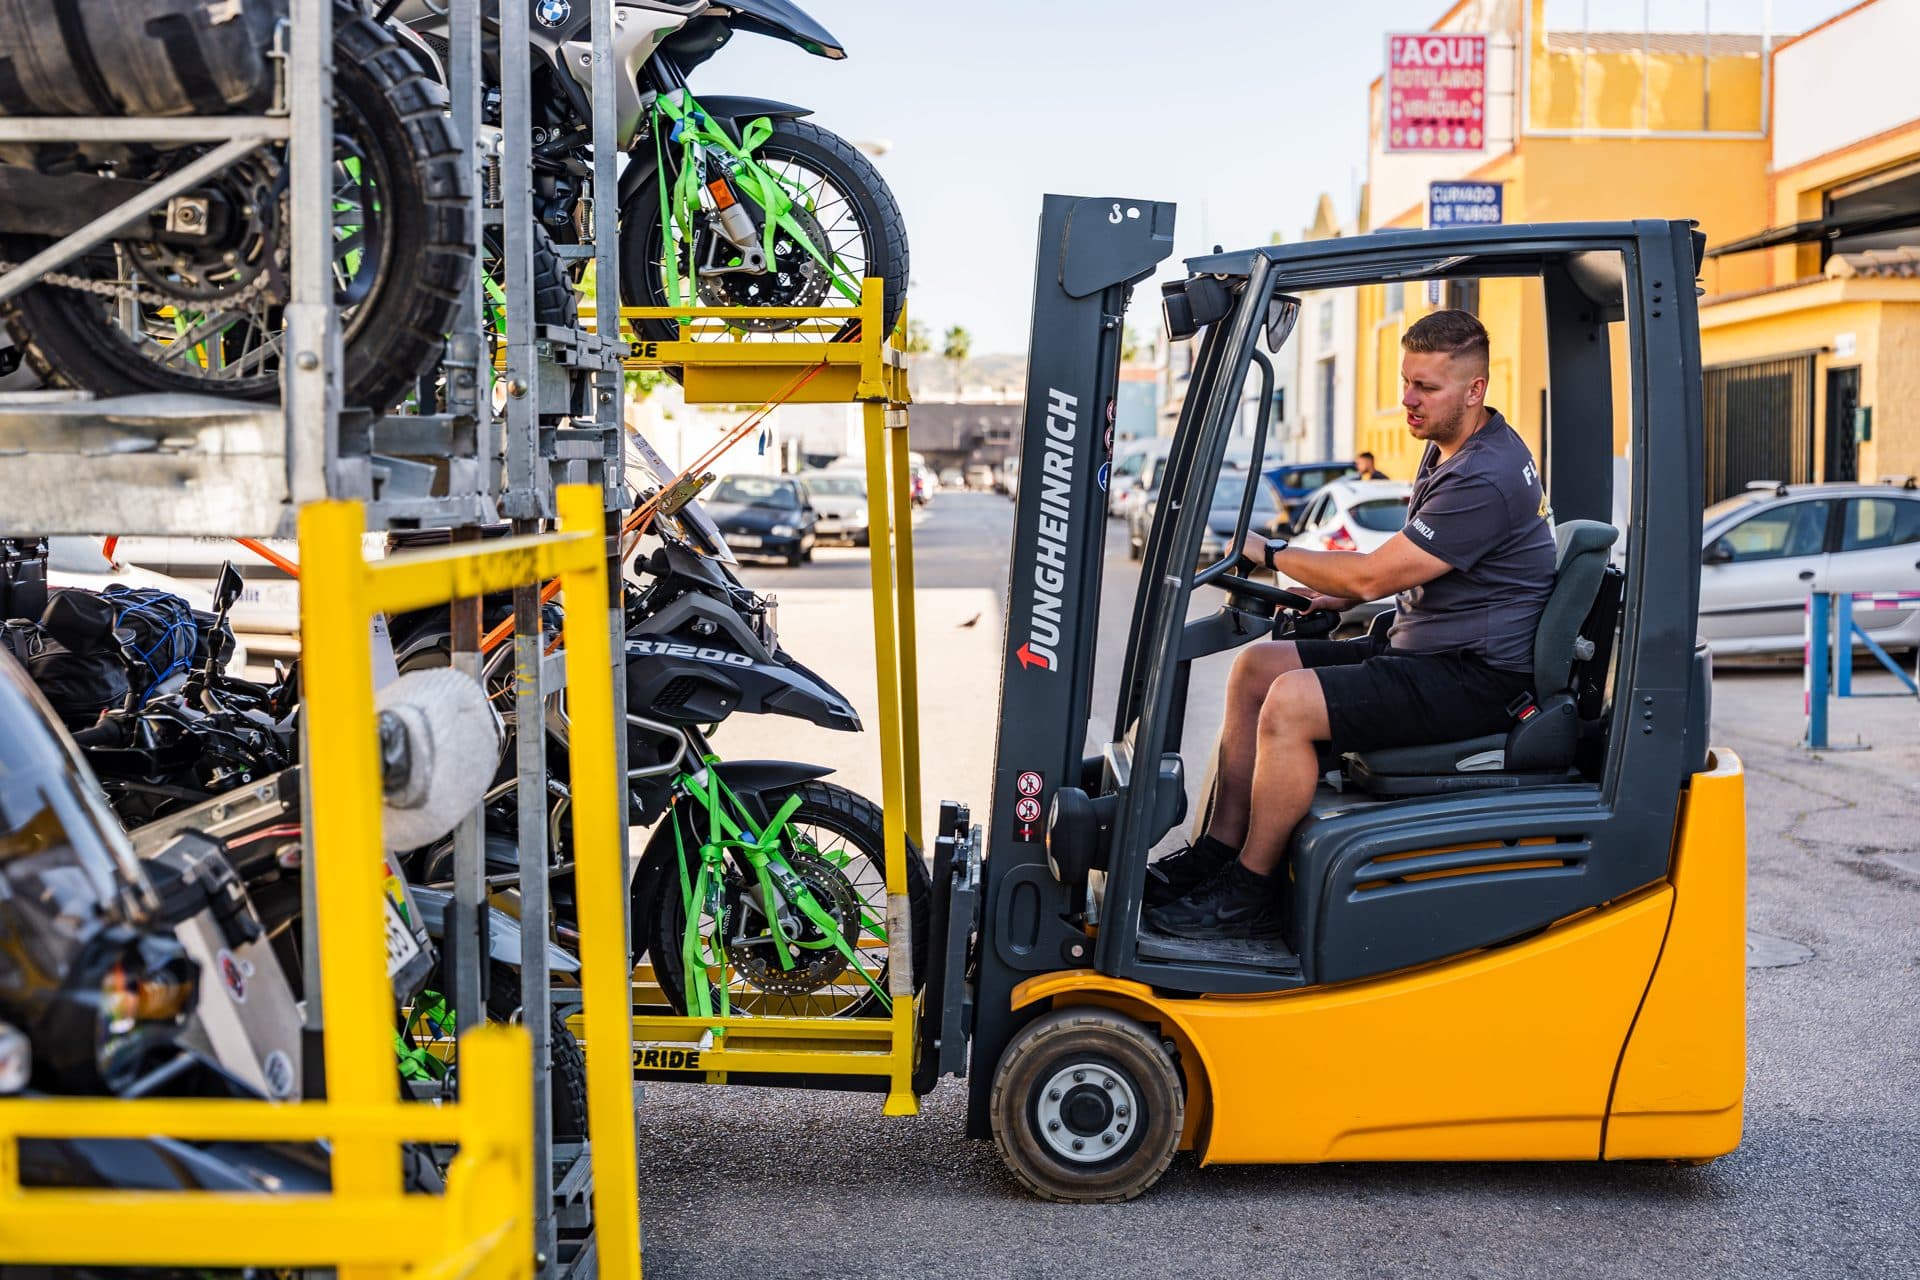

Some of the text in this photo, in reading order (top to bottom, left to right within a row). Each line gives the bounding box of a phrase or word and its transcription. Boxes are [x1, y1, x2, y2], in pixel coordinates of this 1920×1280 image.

[1401, 38, 1474, 66] AQUI
[1433, 204, 1500, 222] DE TUBOS
[1028, 387, 1079, 673] JUNGHEINRICH
[624, 640, 754, 667] R1200
